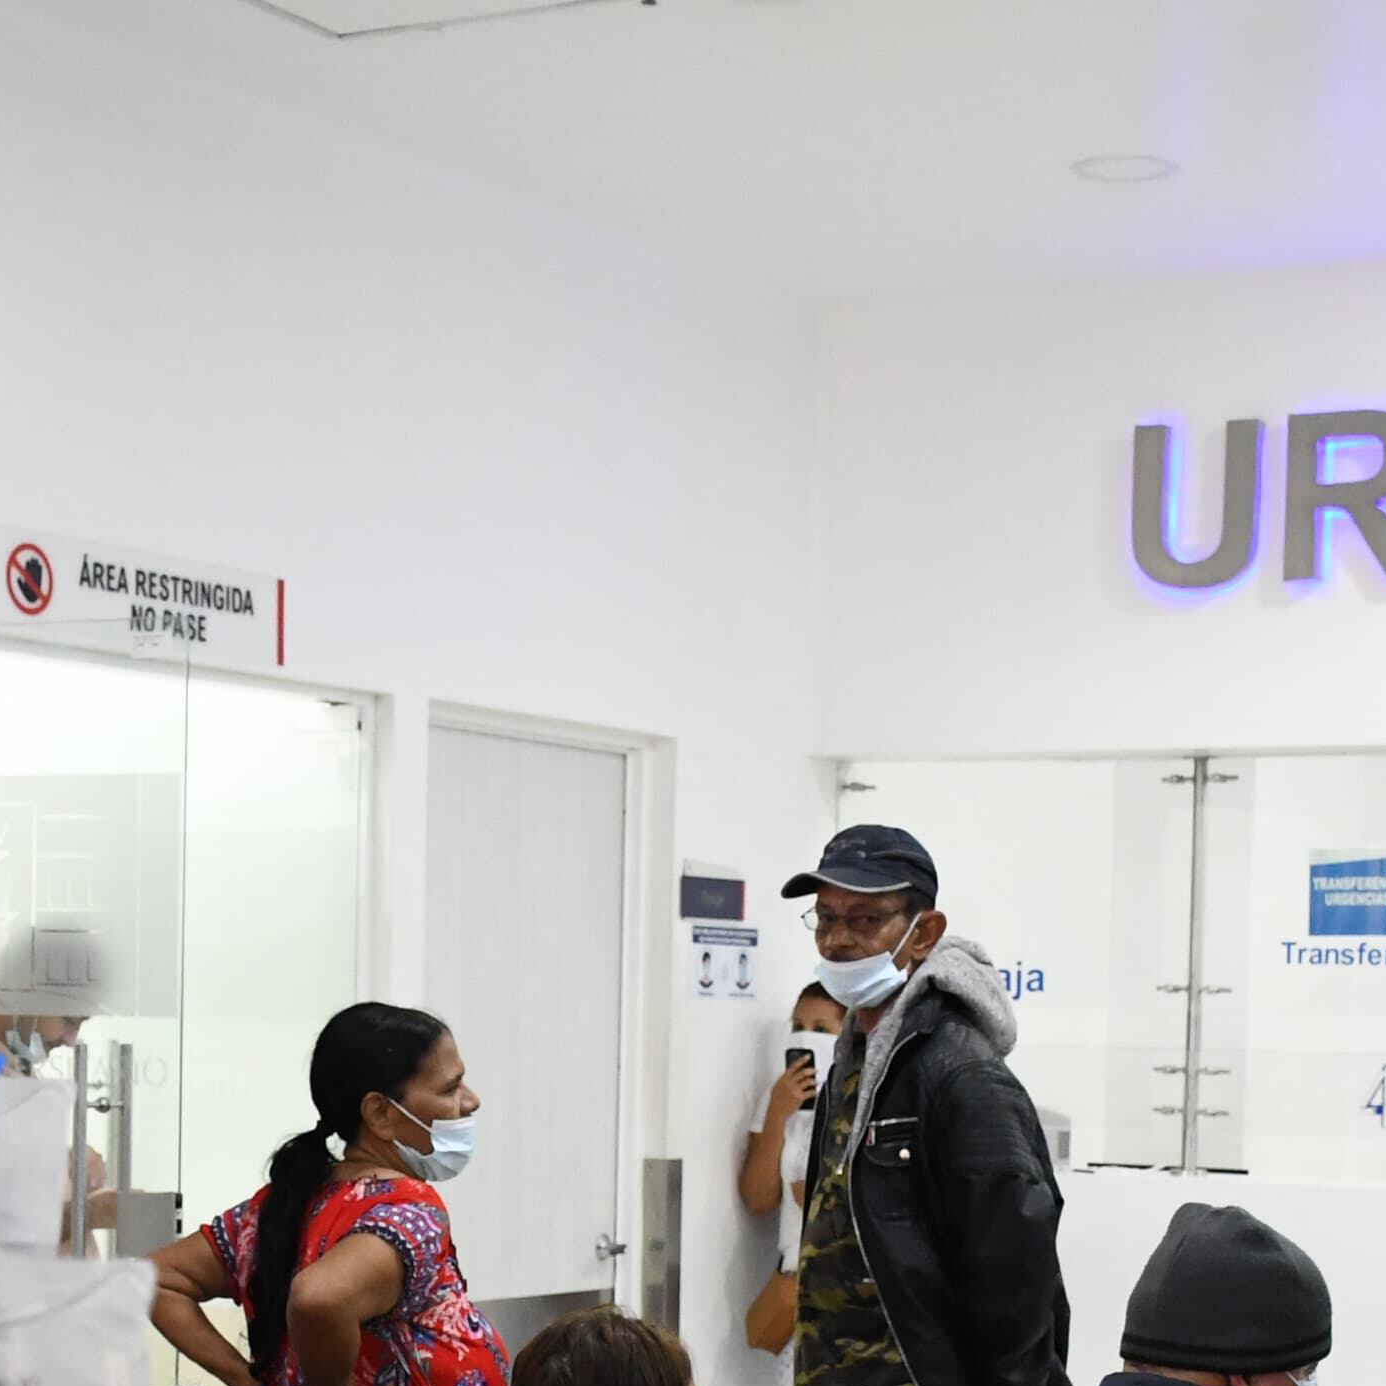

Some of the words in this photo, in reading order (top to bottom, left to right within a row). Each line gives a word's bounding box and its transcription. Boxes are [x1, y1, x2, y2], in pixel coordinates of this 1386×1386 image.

[79, 554, 129, 594] ÁREA
[135, 569, 255, 616] RESTRINGIDA
[130, 604, 156, 632] NO
[163, 610, 207, 642] PASE
[1003, 970, 1046, 1001] aja
